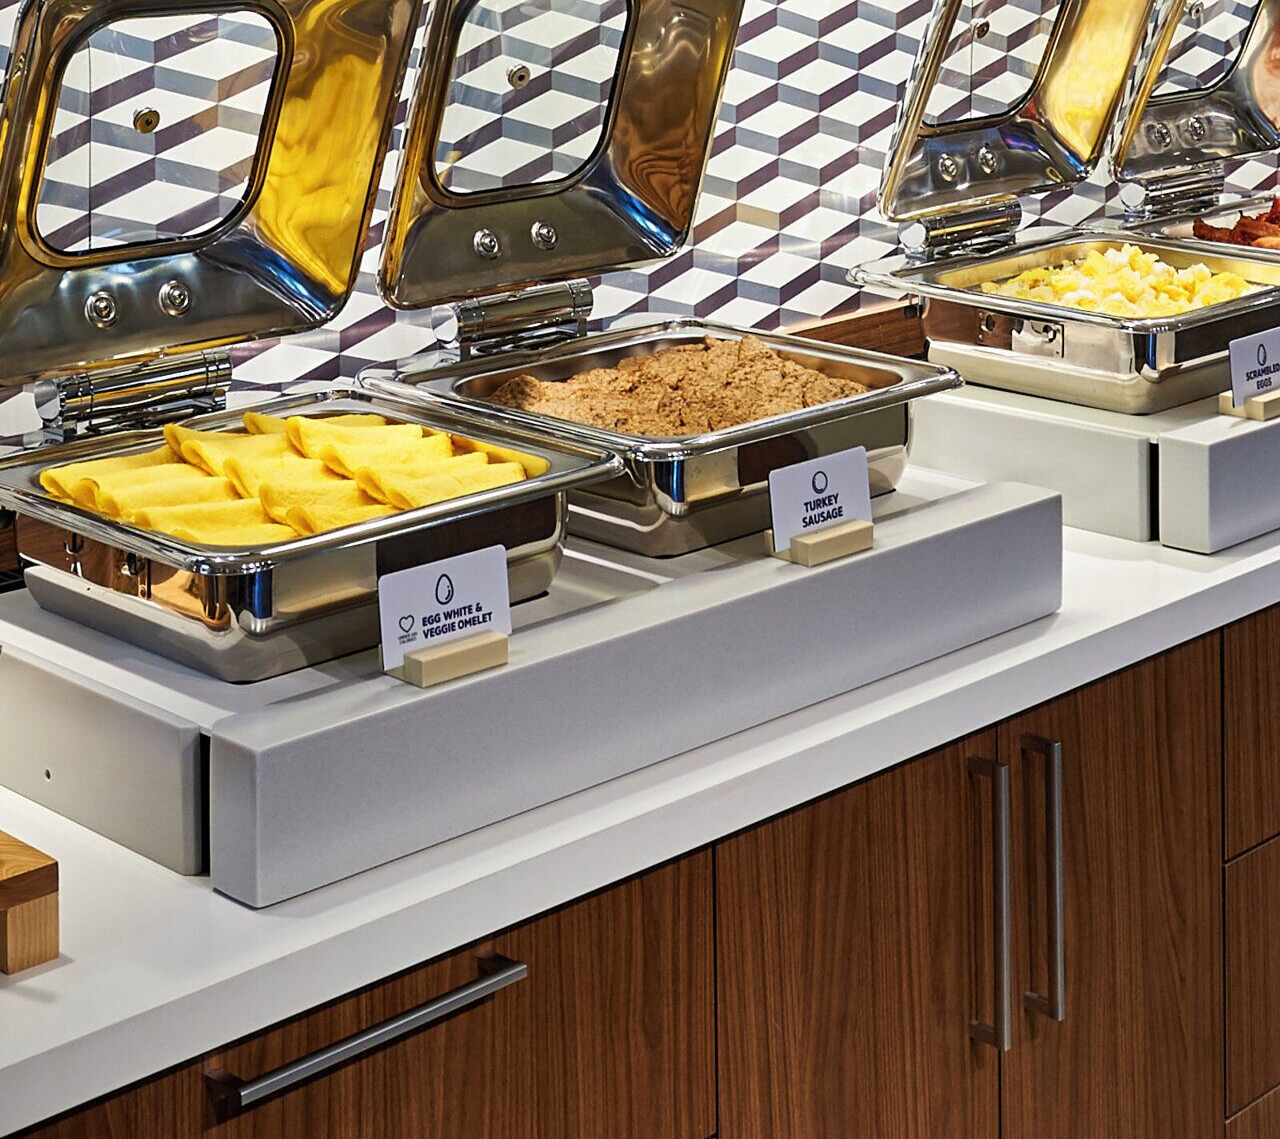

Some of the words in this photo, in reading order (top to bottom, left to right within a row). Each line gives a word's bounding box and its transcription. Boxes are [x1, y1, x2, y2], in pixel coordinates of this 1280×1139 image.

[1245, 362, 1280, 381] SCRAMBLED
[1256, 377, 1273, 390] EGGS
[803, 493, 839, 513] TURKEY
[801, 505, 844, 528] SAUSAGE
[421, 613, 442, 627] EGG
[442, 604, 474, 621] WHITE
[475, 602, 483, 613] &
[422, 621, 457, 639] VEGGIE
[457, 611, 493, 630] OMELET
